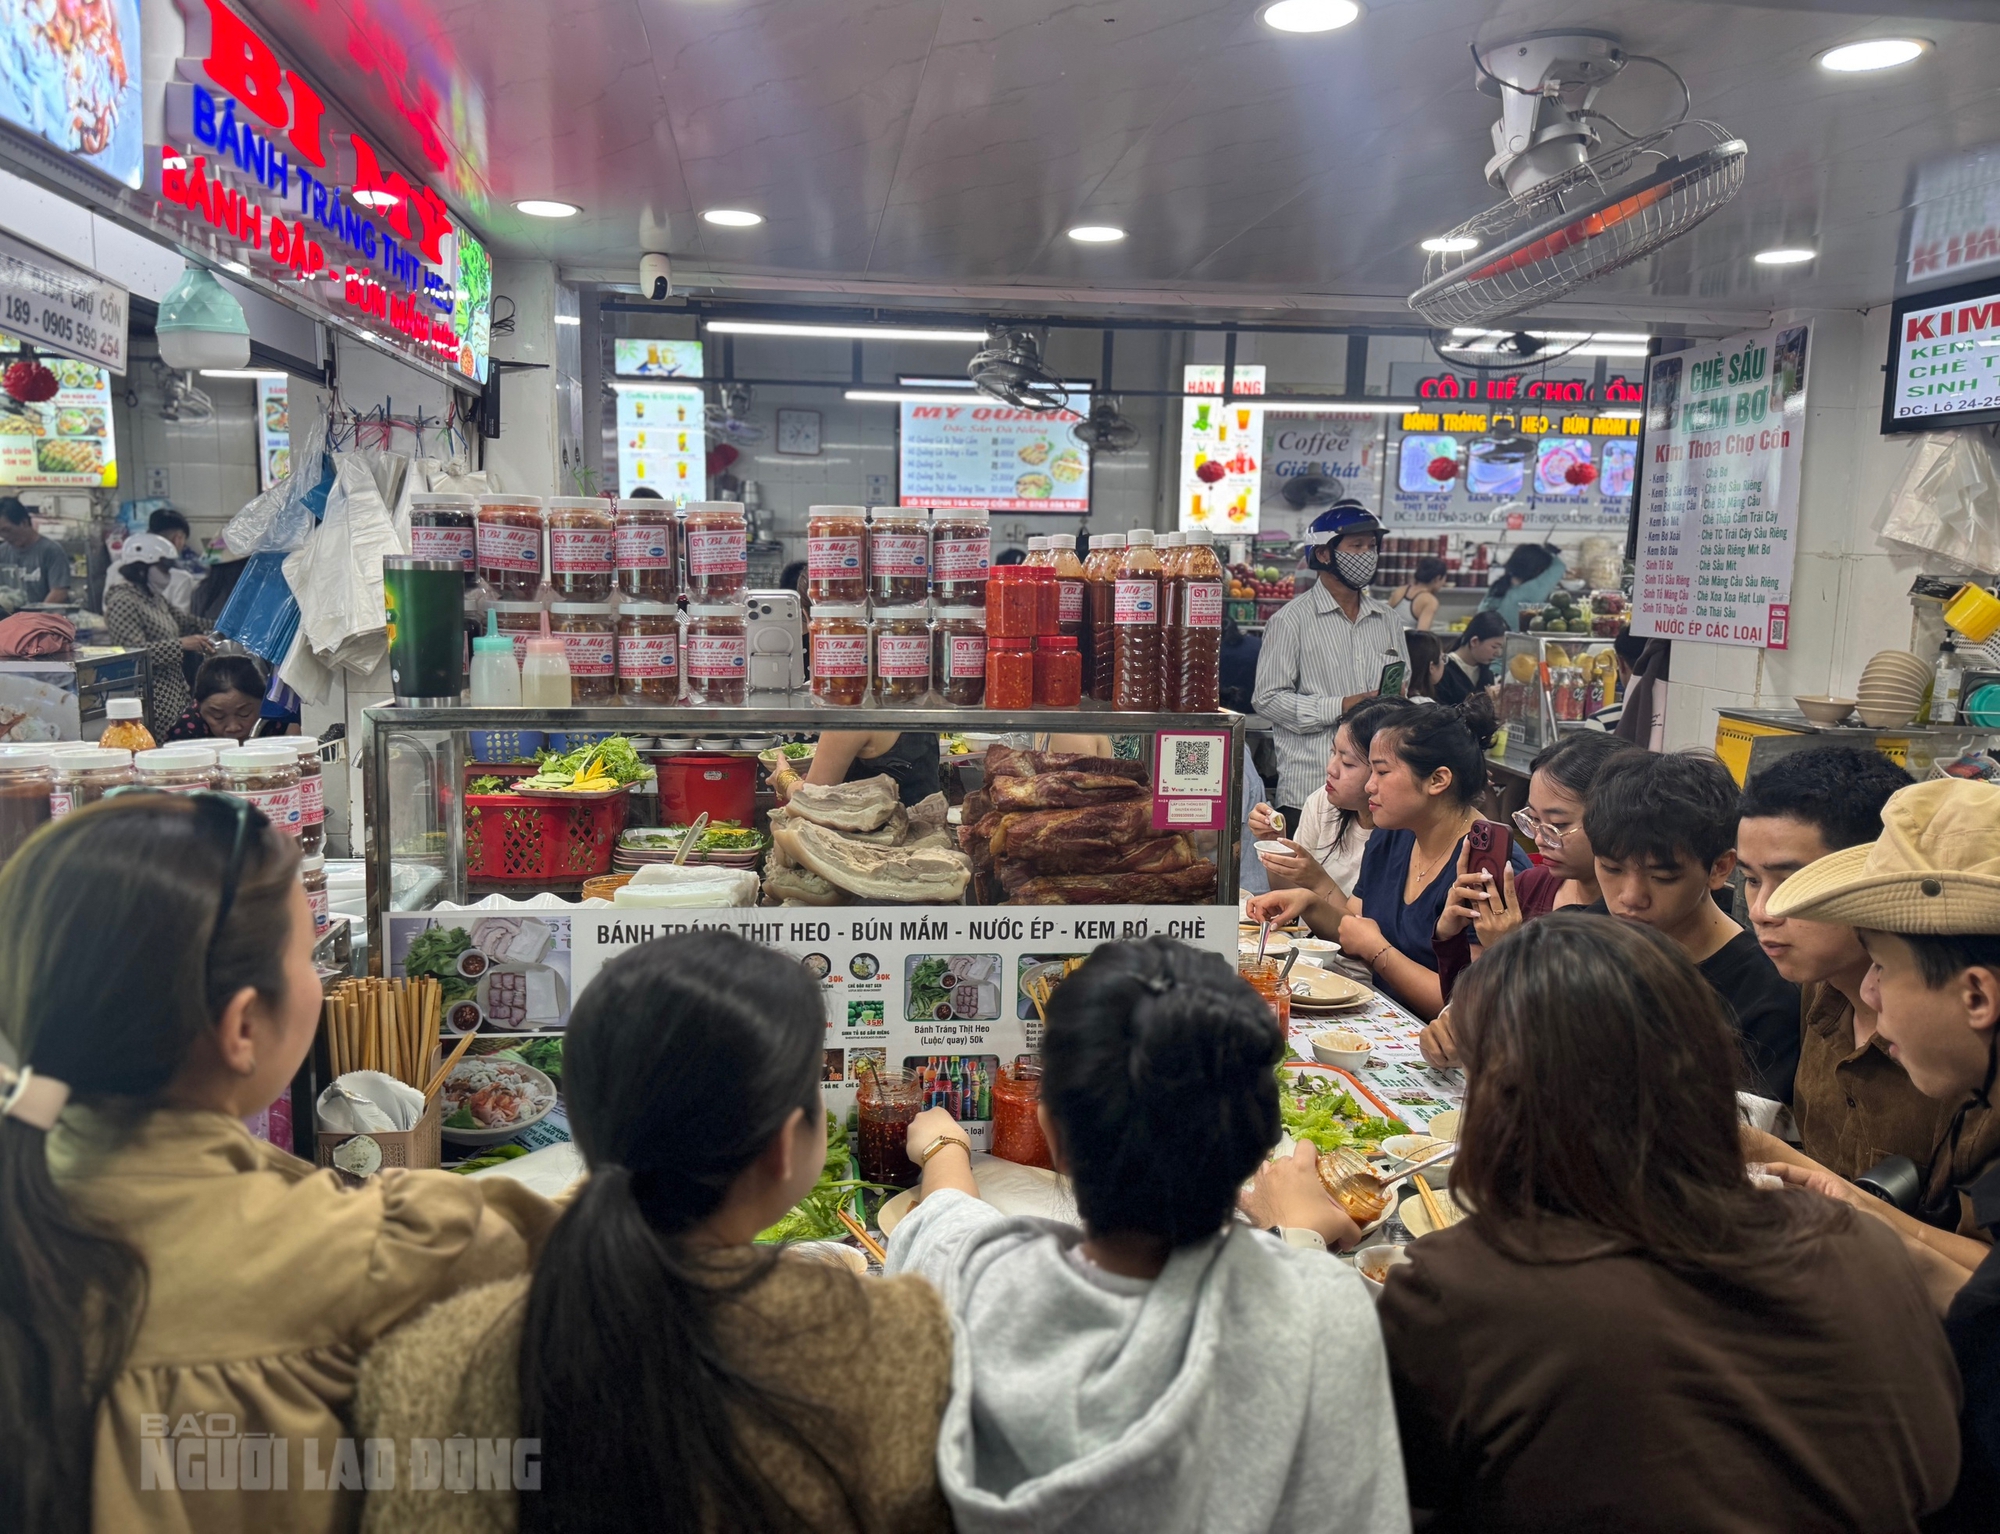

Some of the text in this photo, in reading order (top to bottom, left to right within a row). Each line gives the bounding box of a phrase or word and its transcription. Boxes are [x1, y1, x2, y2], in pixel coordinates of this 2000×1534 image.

[203, 0, 453, 265] BI MỸ
[193, 83, 454, 315] BÁNH TRÁNG THỊT HEO
[162, 144, 262, 250] BÁNH
[345, 265, 387, 321] BÚN
[100, 293, 121, 327] CỒN
[6, 295, 119, 360] 189 0905 599 254
[1906, 301, 2000, 343] KIM
[1911, 339, 1974, 360] KEM
[1690, 351, 1725, 394] CHÈ
[1909, 359, 1968, 379] CHÈ
[1906, 378, 1978, 398] SINH
[1682, 385, 1769, 435] KEM BƠ
[1899, 405, 1928, 417] ĐC:
[1934, 401, 1953, 413] Lô
[1402, 411, 1439, 431] BÁNH
[1443, 411, 1487, 432] TRÁNG
[1521, 415, 1549, 434] HEO
[1562, 413, 1589, 435] BÚN
[1278, 431, 1350, 455] Coffee
[1655, 425, 1790, 463] Kim Thoa Chợ Cồn
[1648, 531, 1660, 541] Kem
[1701, 529, 1713, 540] Chè
[1715, 528, 1723, 540] TC
[1725, 528, 1737, 539] Trái
[1739, 527, 1752, 541] Cây
[1769, 527, 1787, 541] Riêng
[1647, 546, 1659, 556] Kem
[1700, 544, 1712, 556] Chè
[1727, 543, 1746, 557] Riêng
[1646, 560, 1657, 570] Sinh
[1699, 560, 1711, 571] Chè
[1645, 575, 1657, 585] Sinh
[1698, 574, 1710, 586] Chè
[1760, 576, 1779, 590] Riêng
[1643, 589, 1655, 599] Sinh
[1697, 590, 1708, 601] Chè
[1710, 590, 1722, 602] Xoa
[1723, 591, 1736, 603] Xoa
[1642, 603, 1654, 613] Sinh
[1696, 604, 1708, 616] Chè
[1688, 620, 1702, 636] ÉP
[1706, 621, 1729, 639] CÁC
[1734, 625, 1762, 644] LOẠI
[1591, 687, 1604, 702] C2
[597, 916, 1206, 946] BÁNH THỊT HEO BÚN MẮM NƯỚC ÉP KEM BƠ CHÈ
[914, 1024, 990, 1035] Bánh Tráng Thịt Heo
[921, 1036, 984, 1046] (Luộc/ quay) 50k
[970, 1126, 985, 1137] loại
